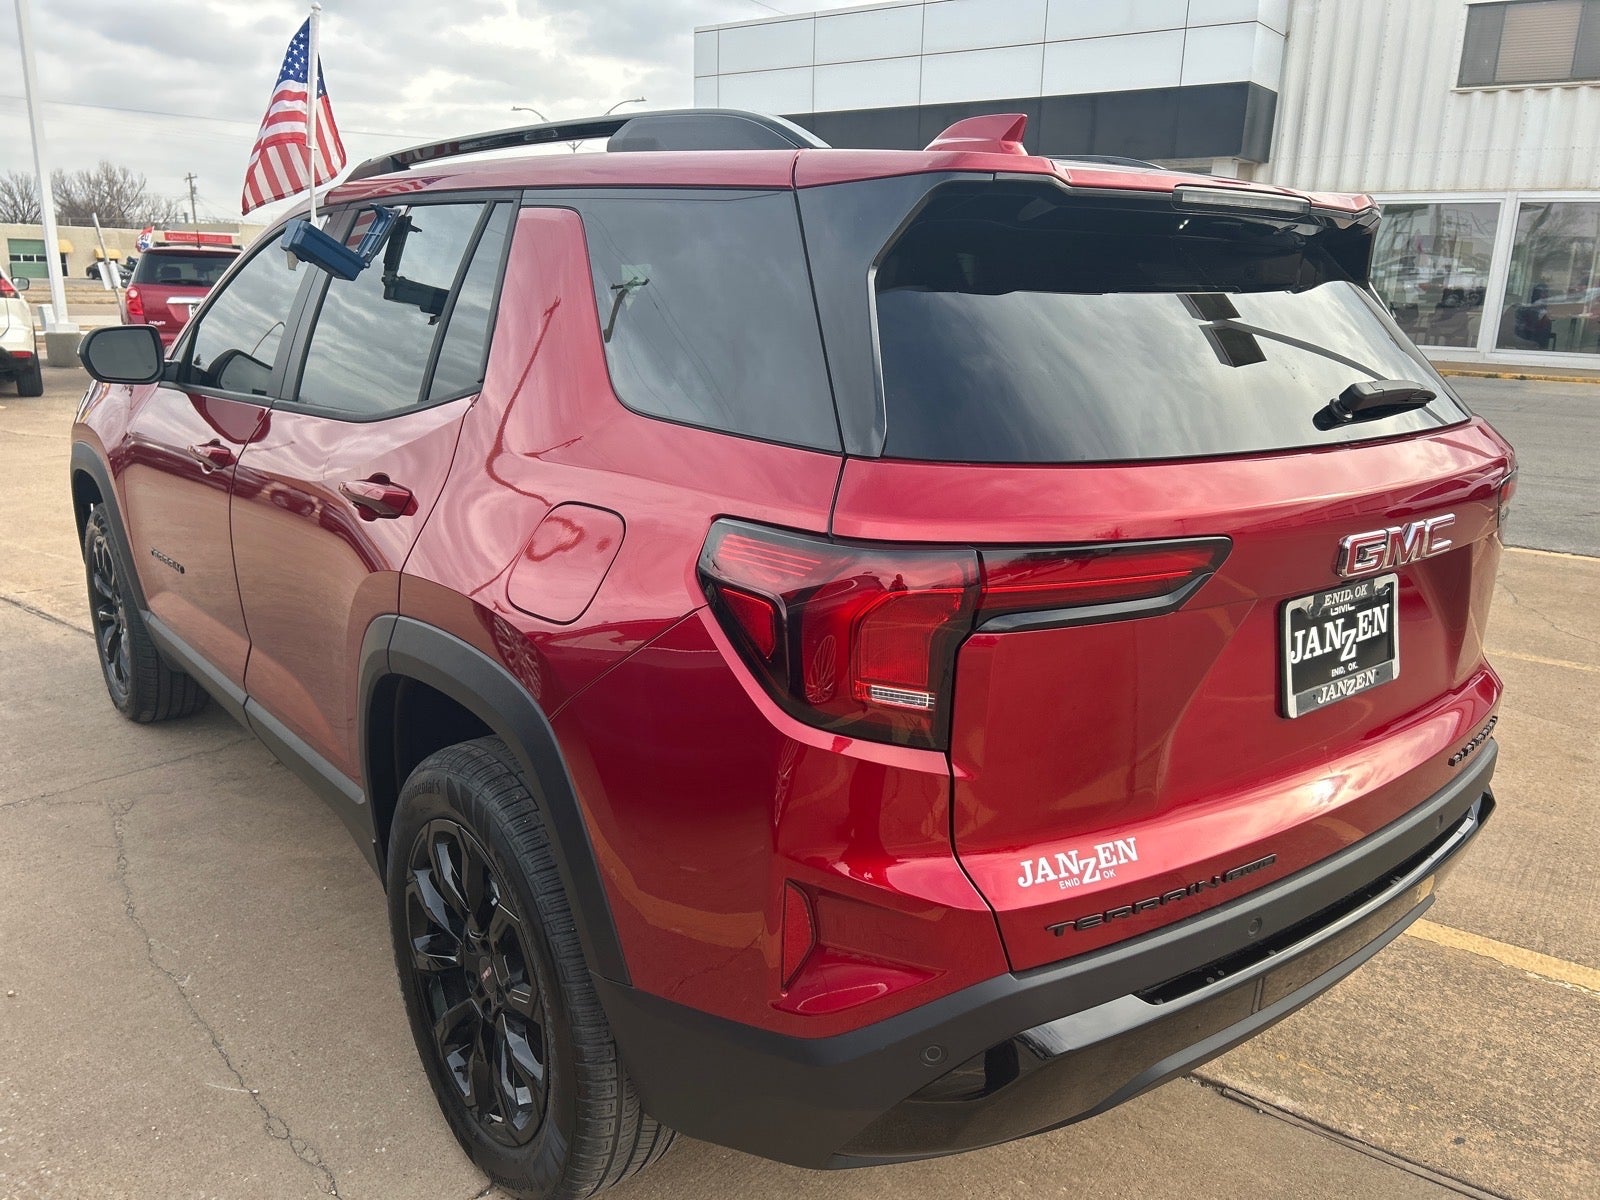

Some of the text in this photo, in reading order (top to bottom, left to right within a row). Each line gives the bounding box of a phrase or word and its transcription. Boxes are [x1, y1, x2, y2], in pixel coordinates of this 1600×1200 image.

[1337, 513, 1456, 577] GMC
[1323, 583, 1369, 607] ENID, OK
[1290, 603, 1390, 665] JANZEN
[1317, 668, 1377, 704] JANZEN
[1017, 837, 1139, 888] JANZEN
[1059, 869, 1117, 890] ENID OK
[1045, 875, 1221, 937] TERRAIN
